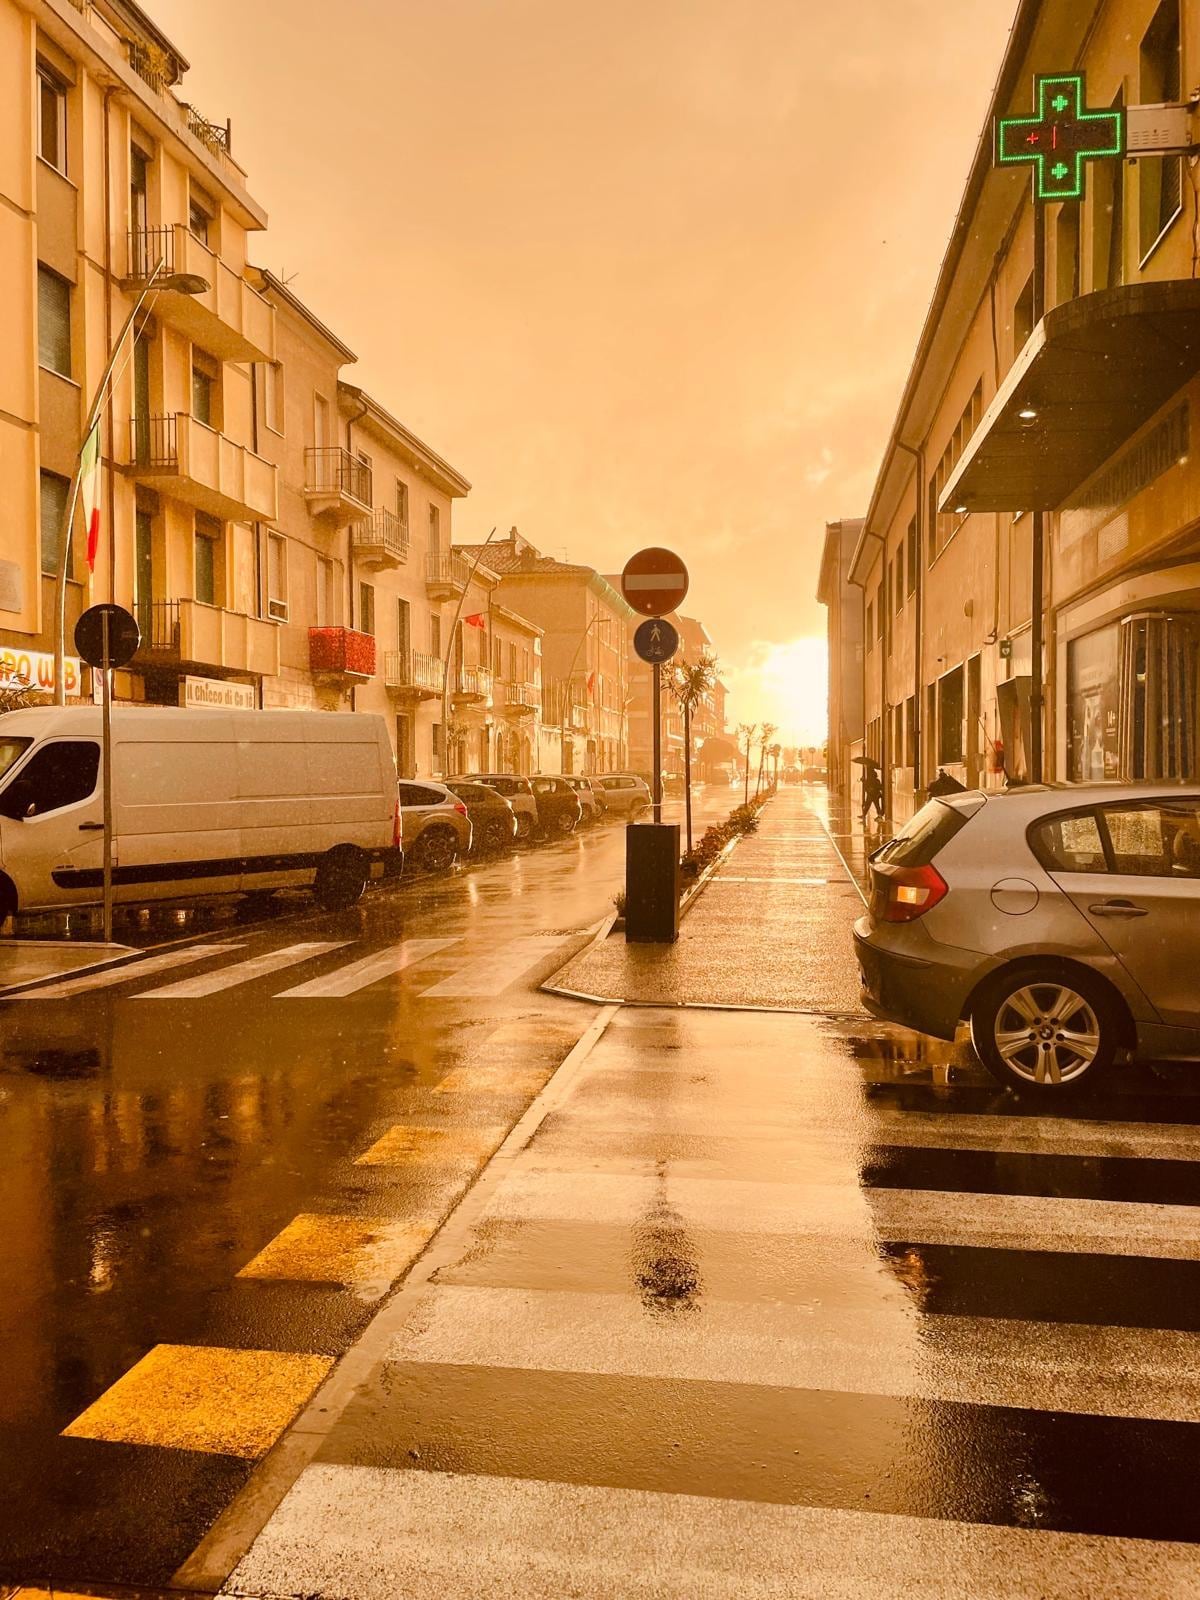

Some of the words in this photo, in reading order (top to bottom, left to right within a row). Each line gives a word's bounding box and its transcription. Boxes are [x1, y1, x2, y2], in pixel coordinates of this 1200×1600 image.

[37, 656, 77, 690] WB
[195, 683, 223, 704] Chicco
[224, 689, 233, 705] di
